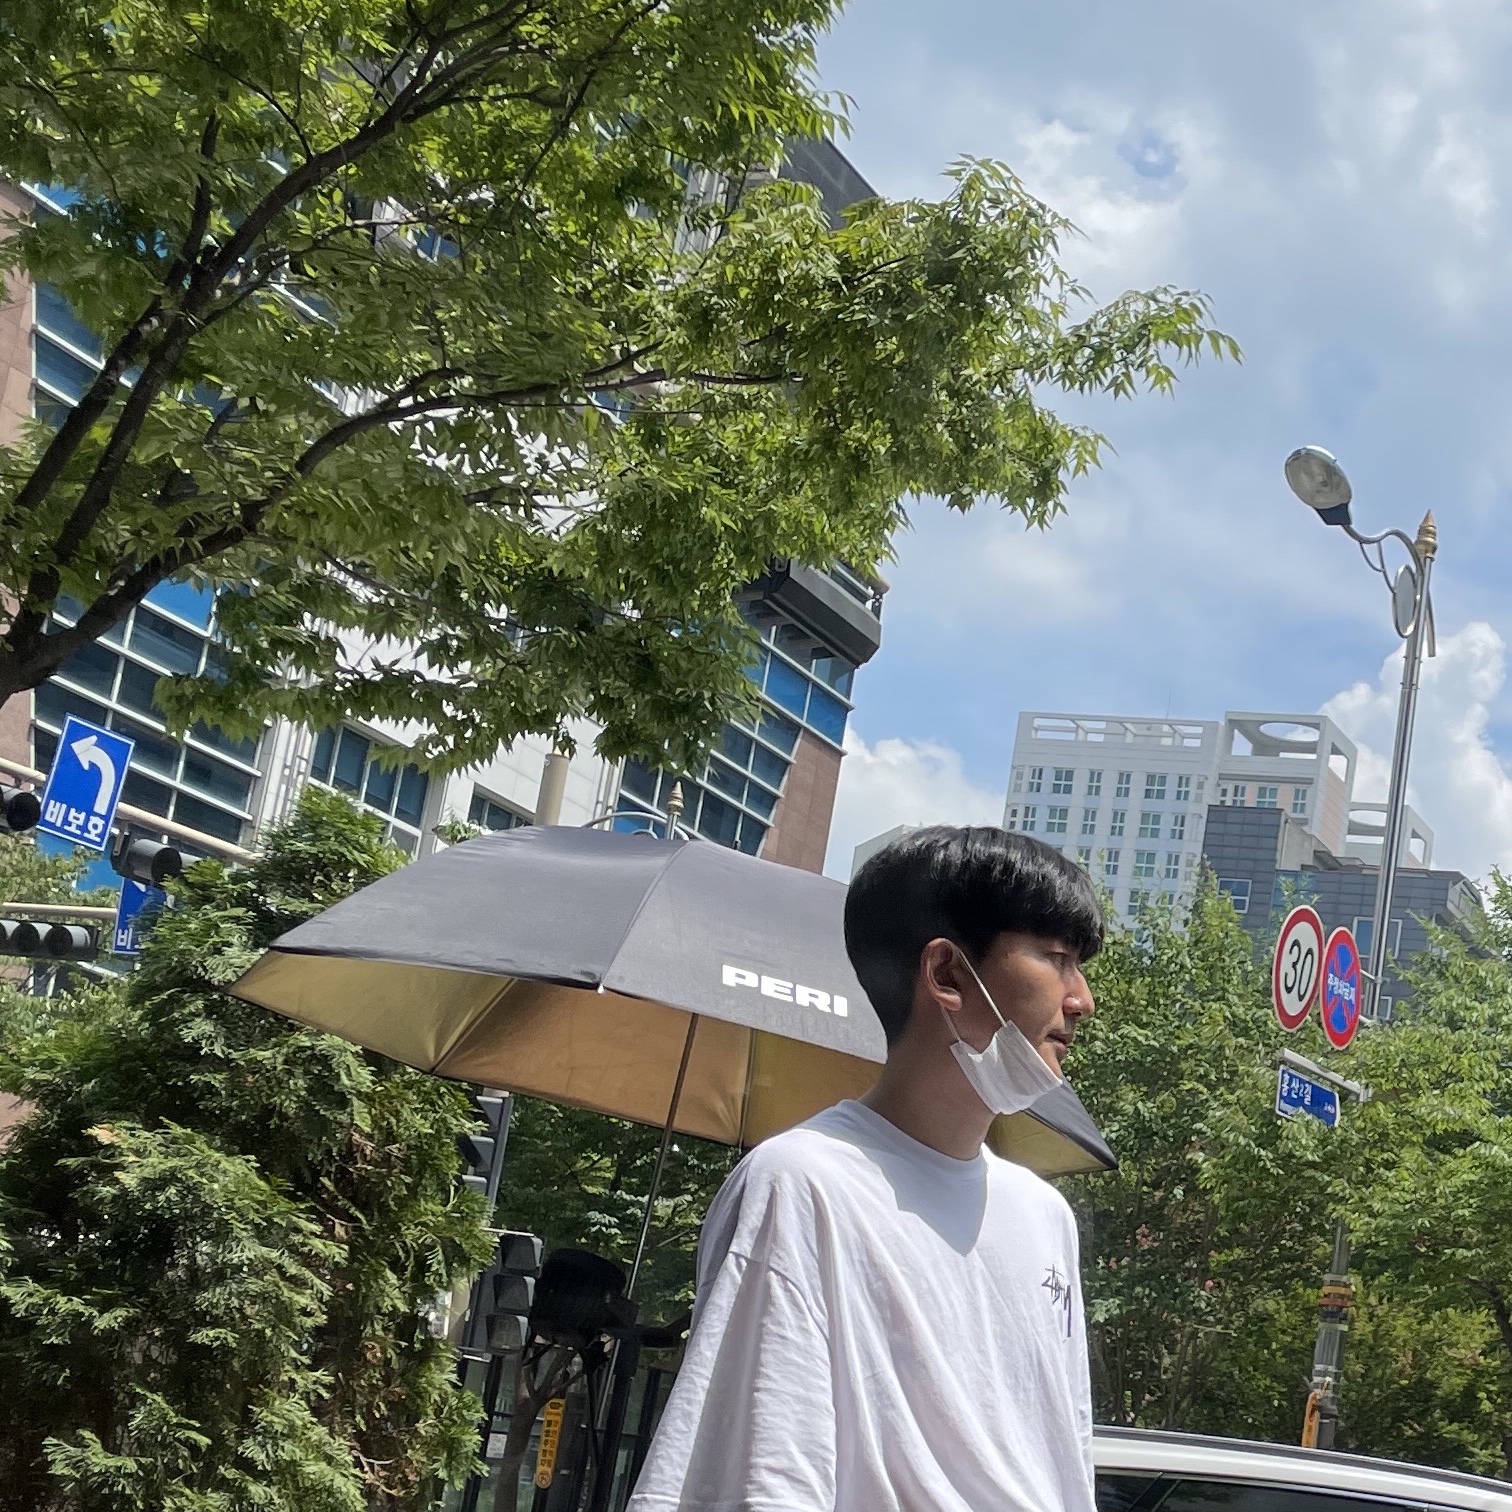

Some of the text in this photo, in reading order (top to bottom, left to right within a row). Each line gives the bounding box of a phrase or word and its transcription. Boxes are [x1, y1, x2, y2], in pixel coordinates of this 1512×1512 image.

[44, 799, 106, 843] 비보호
[722, 964, 848, 1017] PERI
[1284, 938, 1315, 1003] 30
